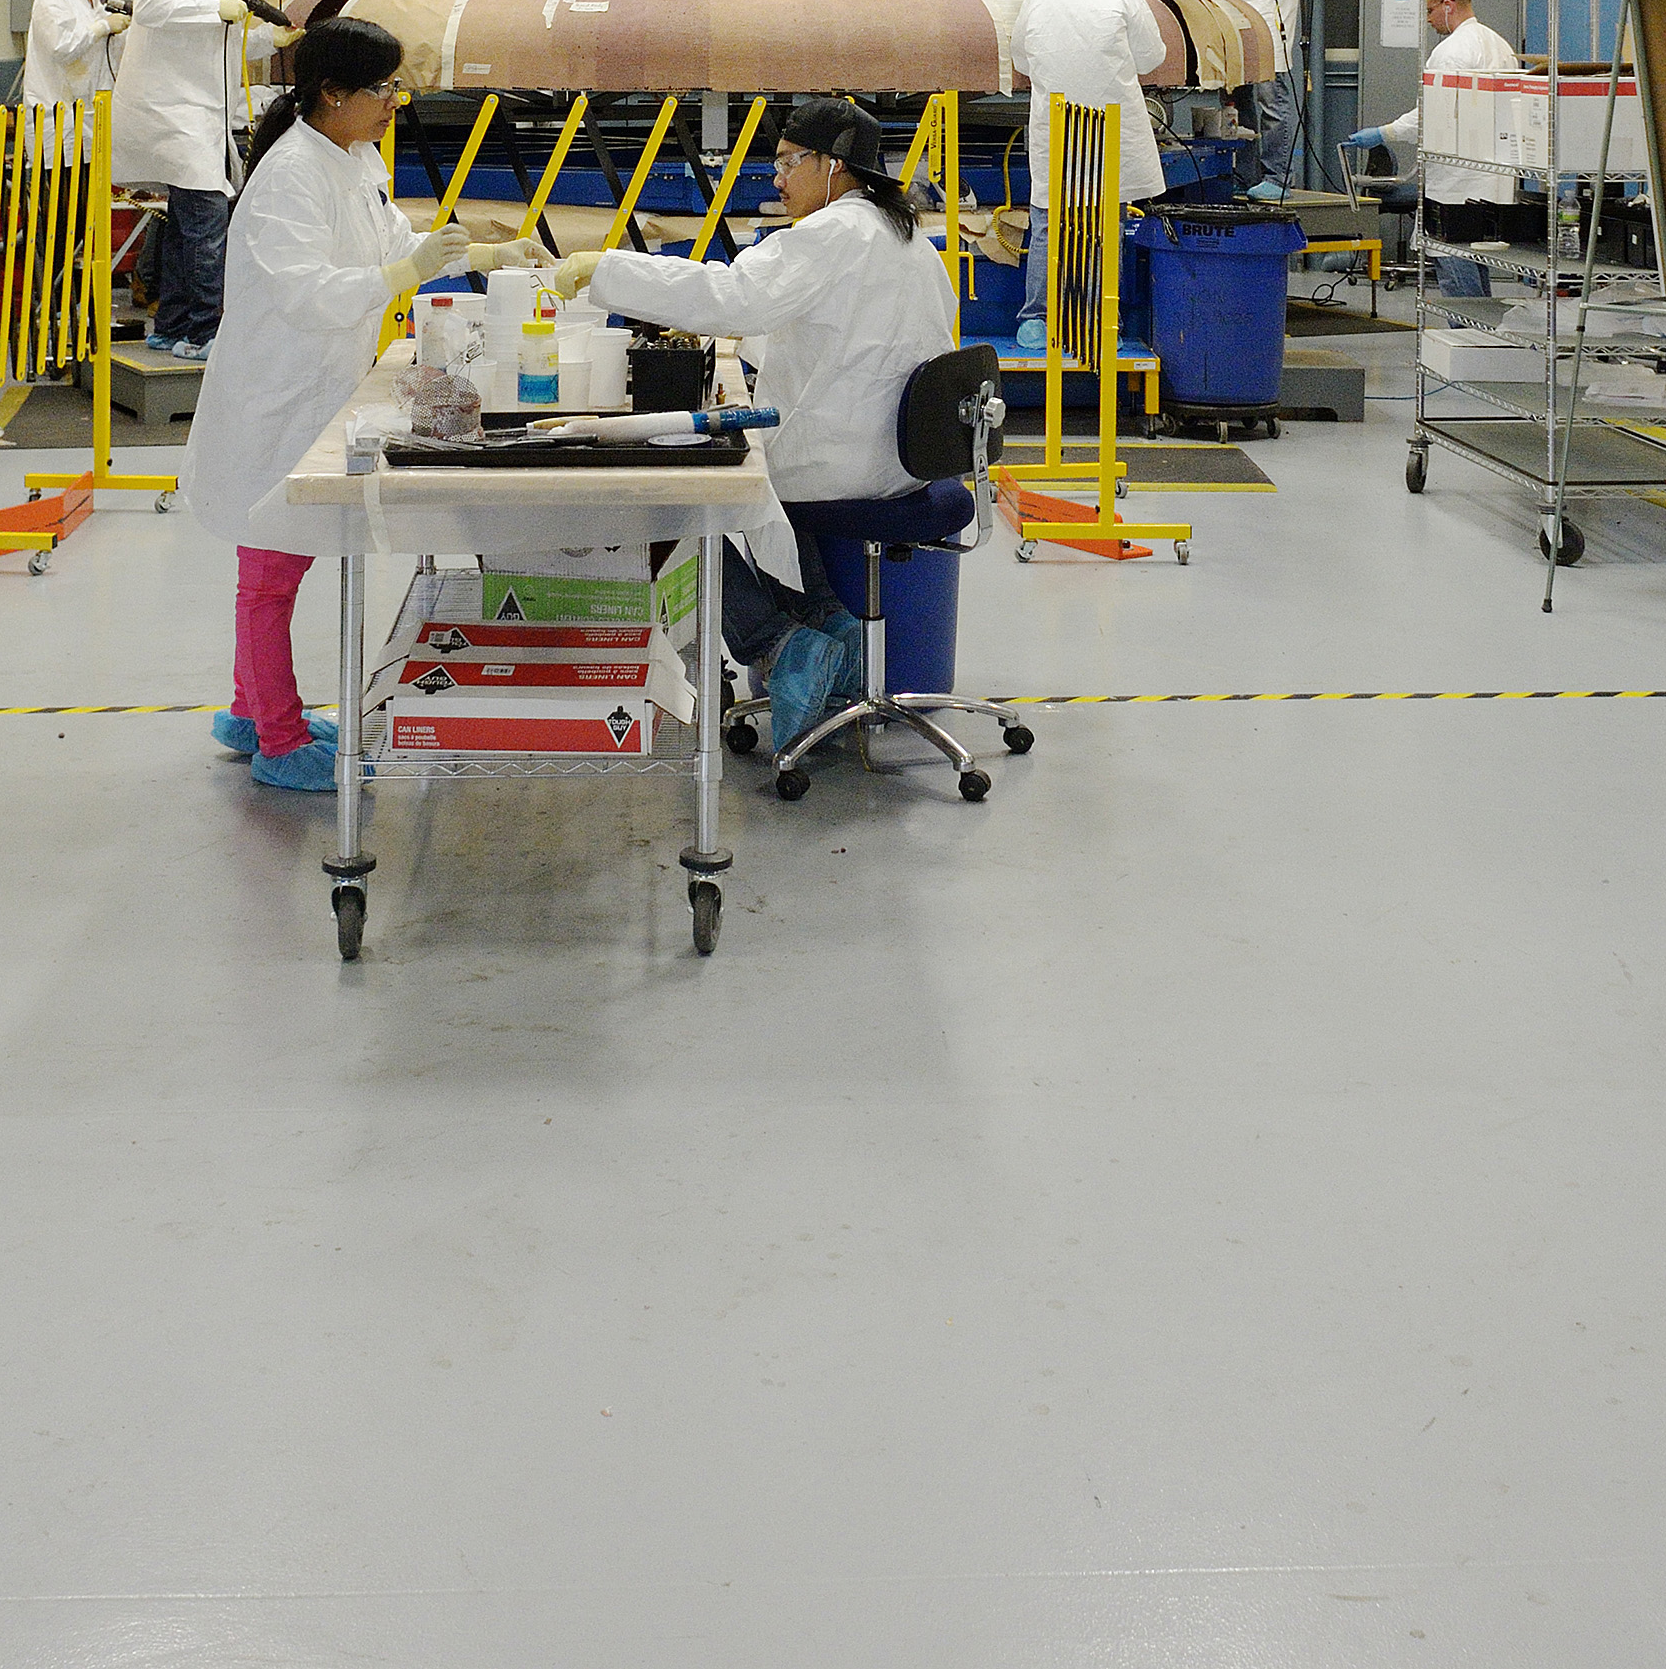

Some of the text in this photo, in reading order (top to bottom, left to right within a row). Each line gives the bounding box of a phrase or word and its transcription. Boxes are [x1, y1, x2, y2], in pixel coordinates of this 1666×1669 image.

[1182, 223, 1236, 238] BRUTE
[590, 604, 622, 616] LINERS
[607, 717, 632, 726] TOUGH
[397, 726, 436, 734] CAN LINERS
[612, 724, 628, 732] GUY
